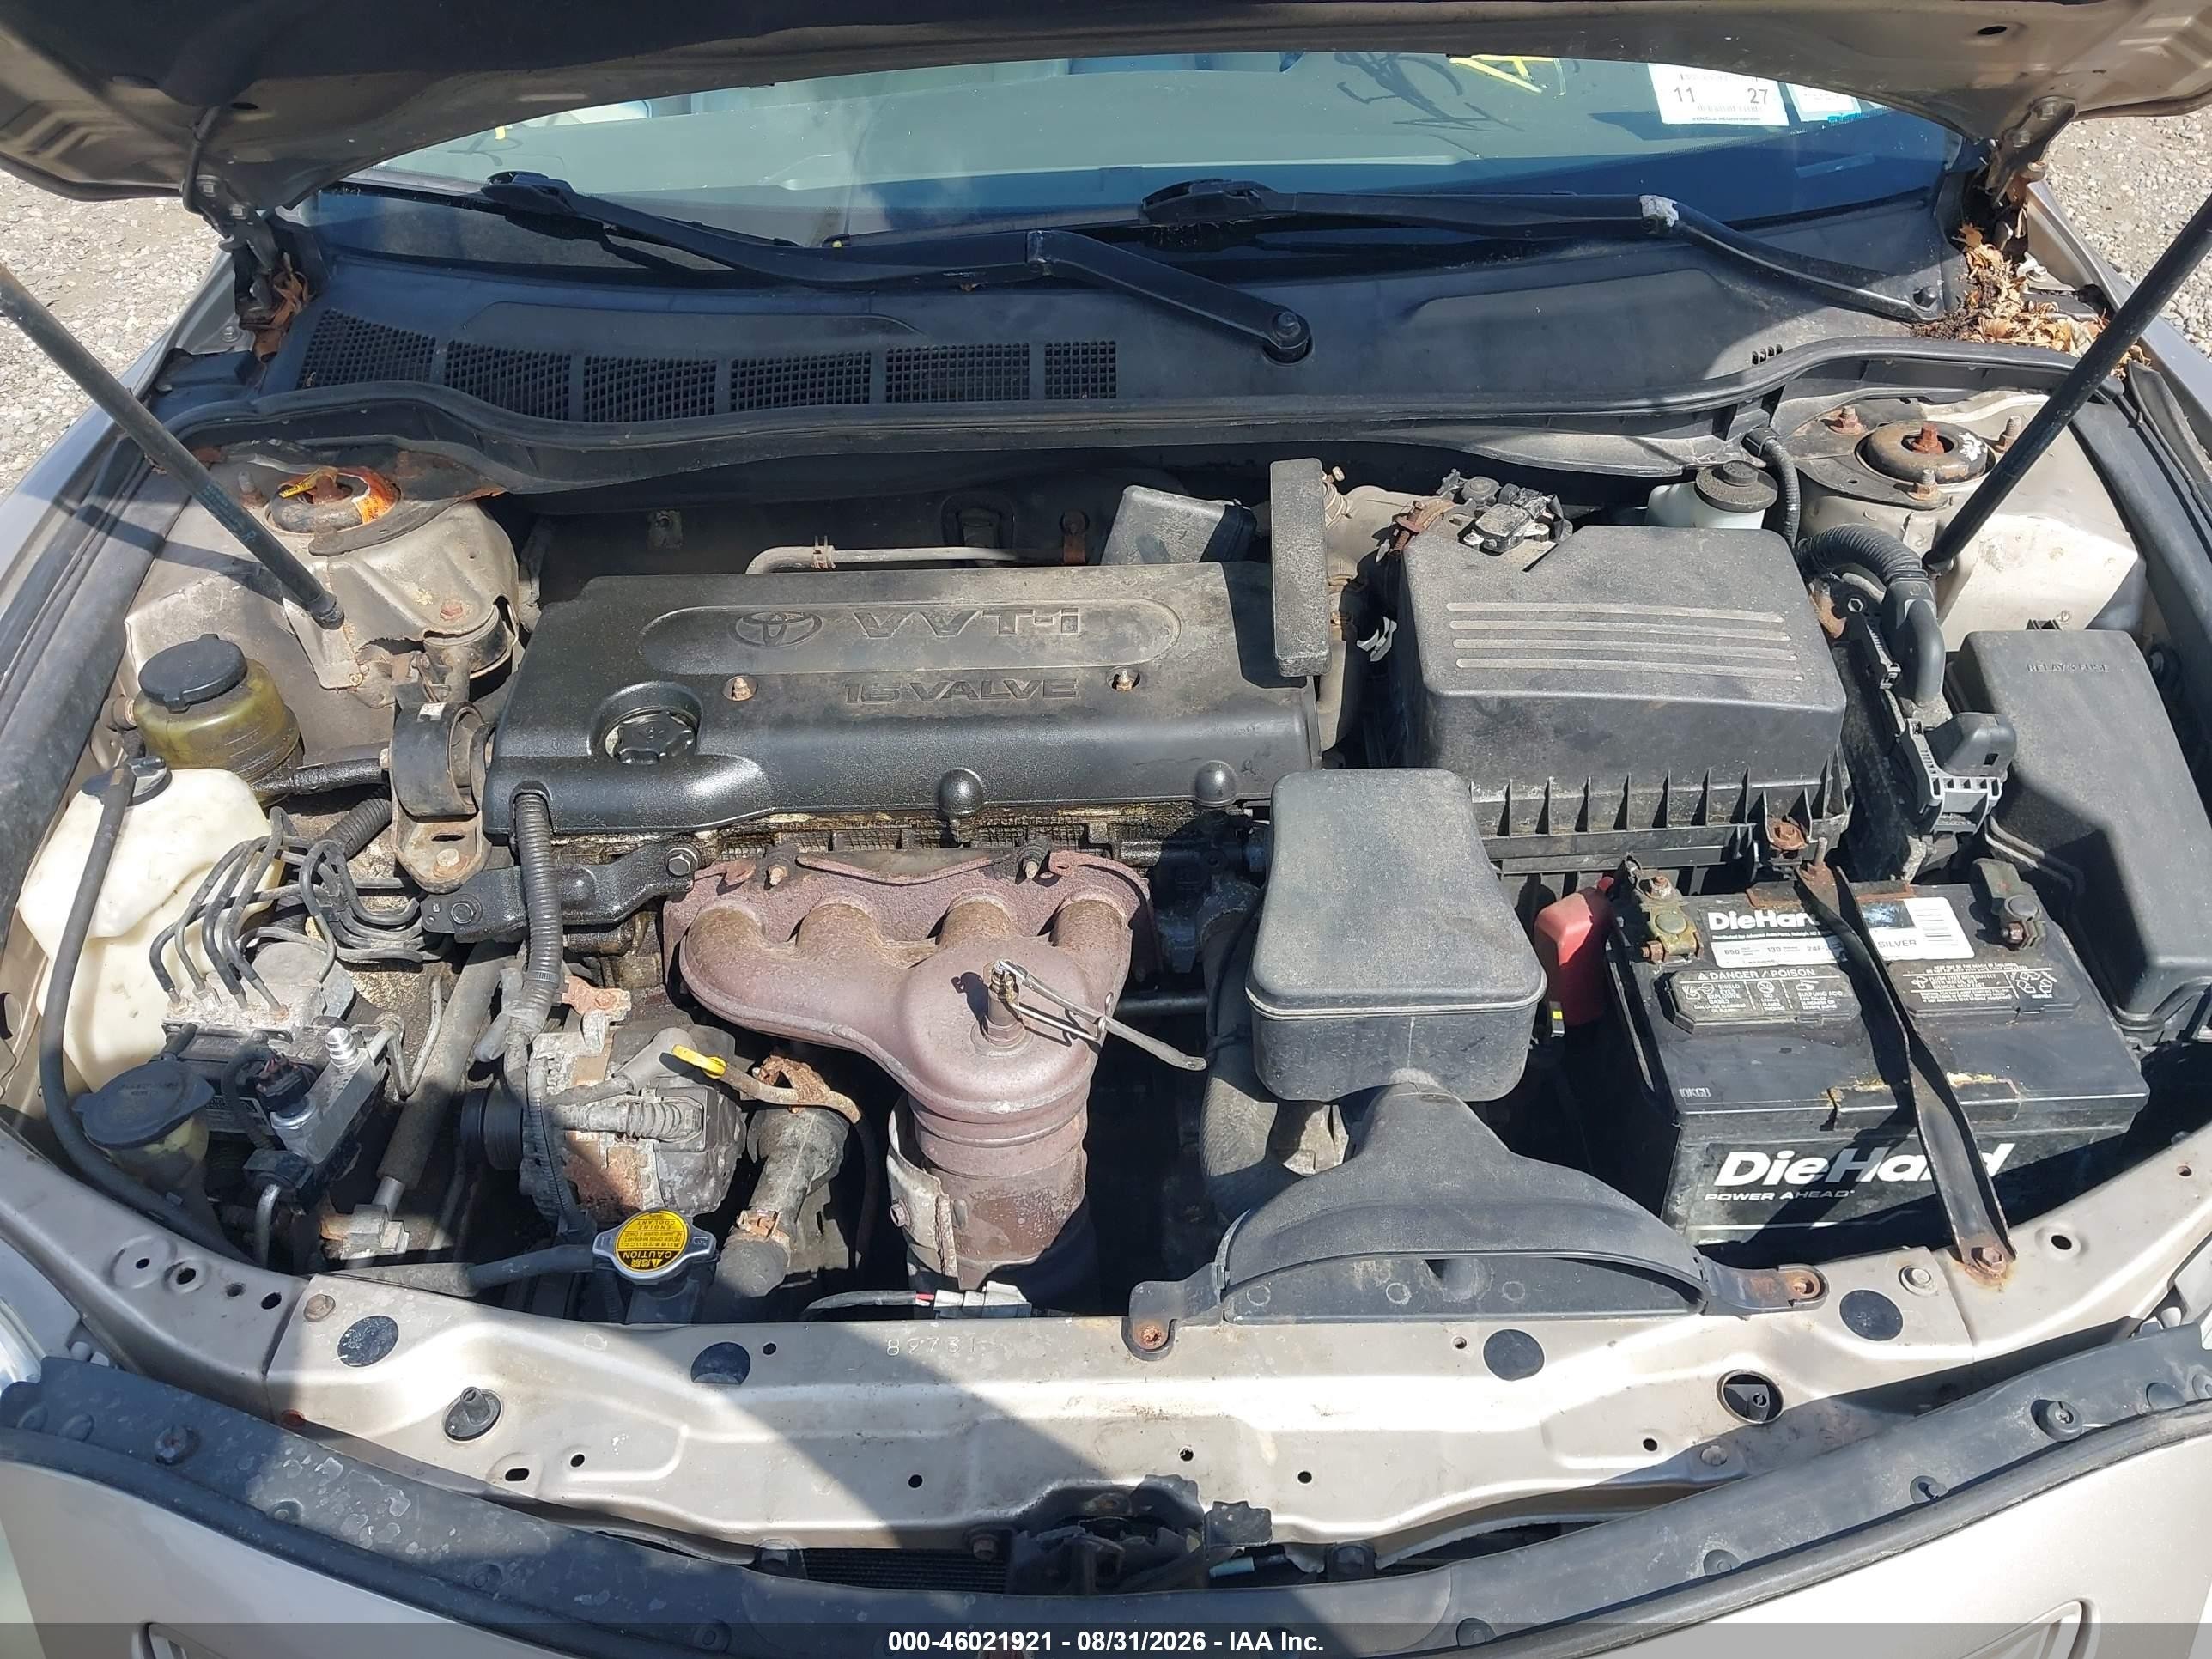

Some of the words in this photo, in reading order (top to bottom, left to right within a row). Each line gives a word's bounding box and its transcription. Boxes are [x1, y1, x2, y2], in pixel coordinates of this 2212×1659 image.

[1673, 86, 1696, 103] 11
[1747, 88, 1768, 105] 27
[2027, 663, 2066, 672] RELAY
[2078, 663, 2110, 672] FUSE
[844, 682, 901, 704] 16
[909, 678, 1079, 702] VALVE
[1707, 909, 1818, 931] DieHar
[1877, 939, 1917, 948] SILVER
[1710, 971, 1759, 980] DANGER
[1771, 969, 1816, 977] POISON
[1713, 1143, 2014, 1187] DieHad
[1705, 1192, 1776, 1201] POWER
